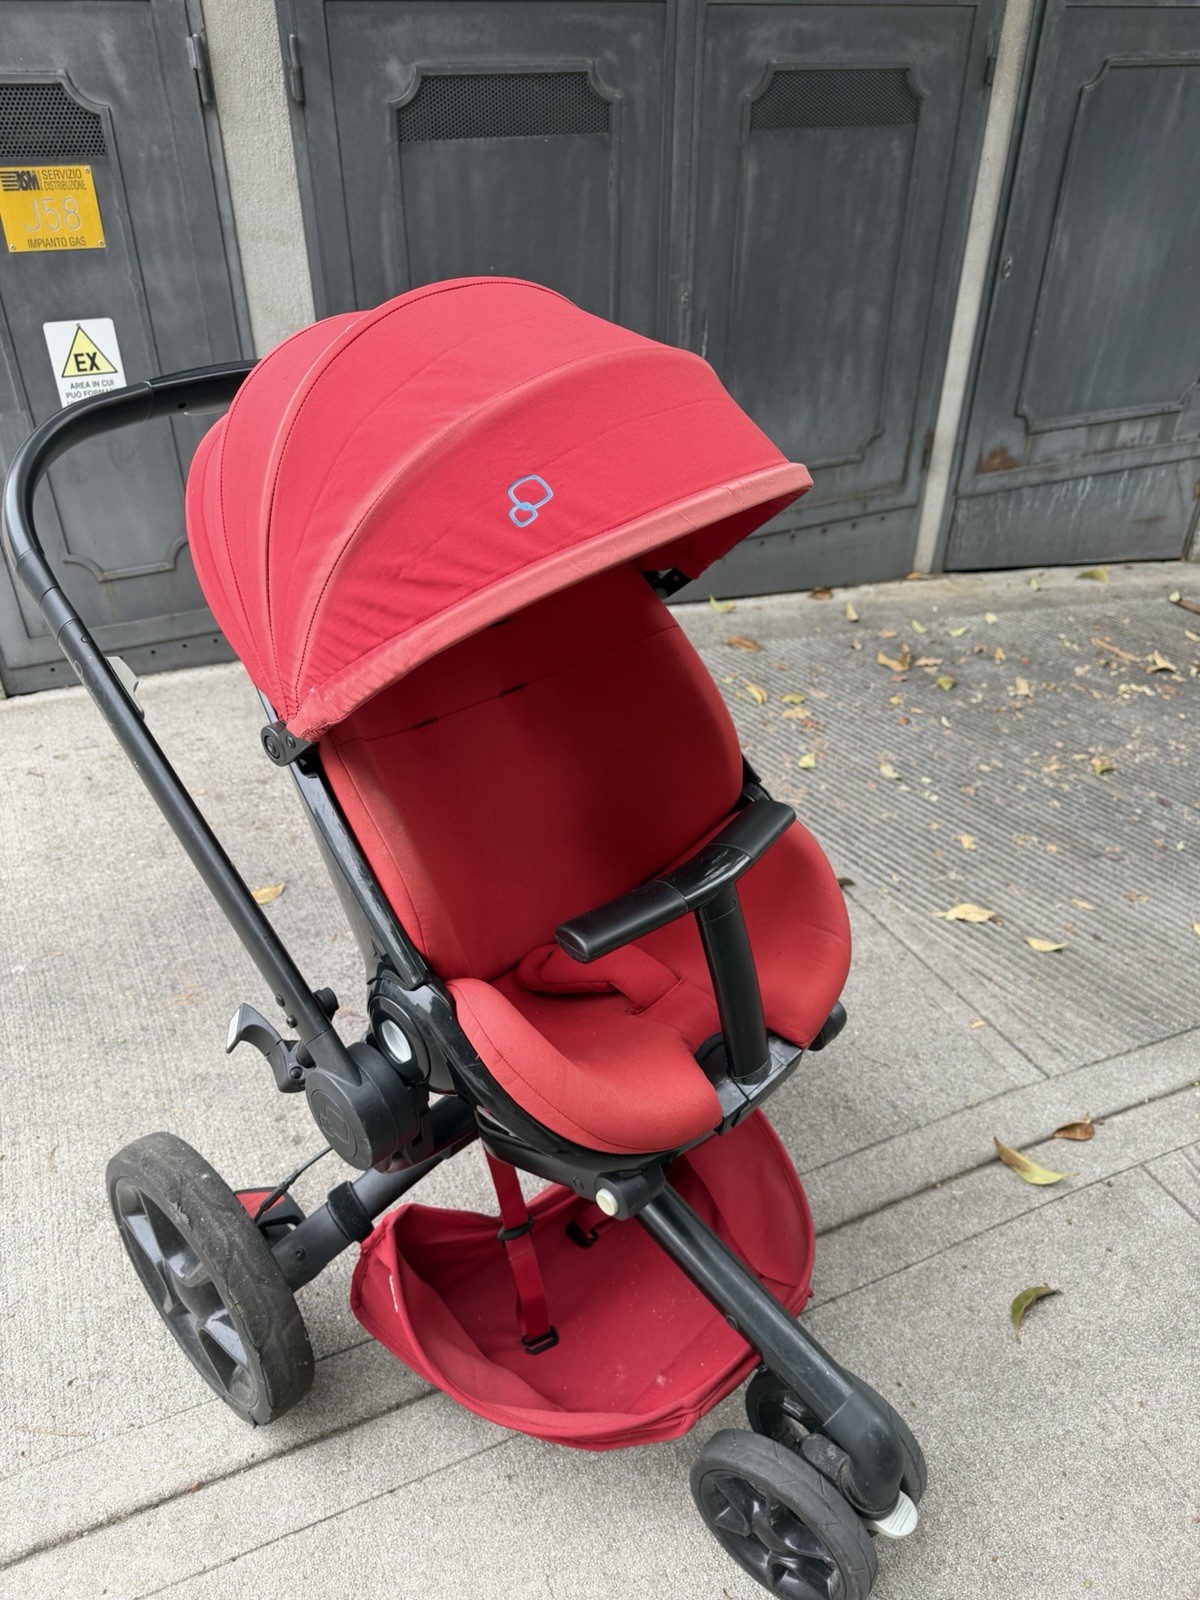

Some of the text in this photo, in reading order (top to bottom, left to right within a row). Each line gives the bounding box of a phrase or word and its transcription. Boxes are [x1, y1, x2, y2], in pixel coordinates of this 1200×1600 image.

[41, 169, 82, 180] SERVIZIO
[44, 180, 87, 191] DISTRIBUZIONE
[24, 196, 82, 232] J58
[27, 236, 87, 249] IMPIANTO GAS
[73, 352, 101, 373] EX
[70, 379, 114, 390] AREA IN CUI
